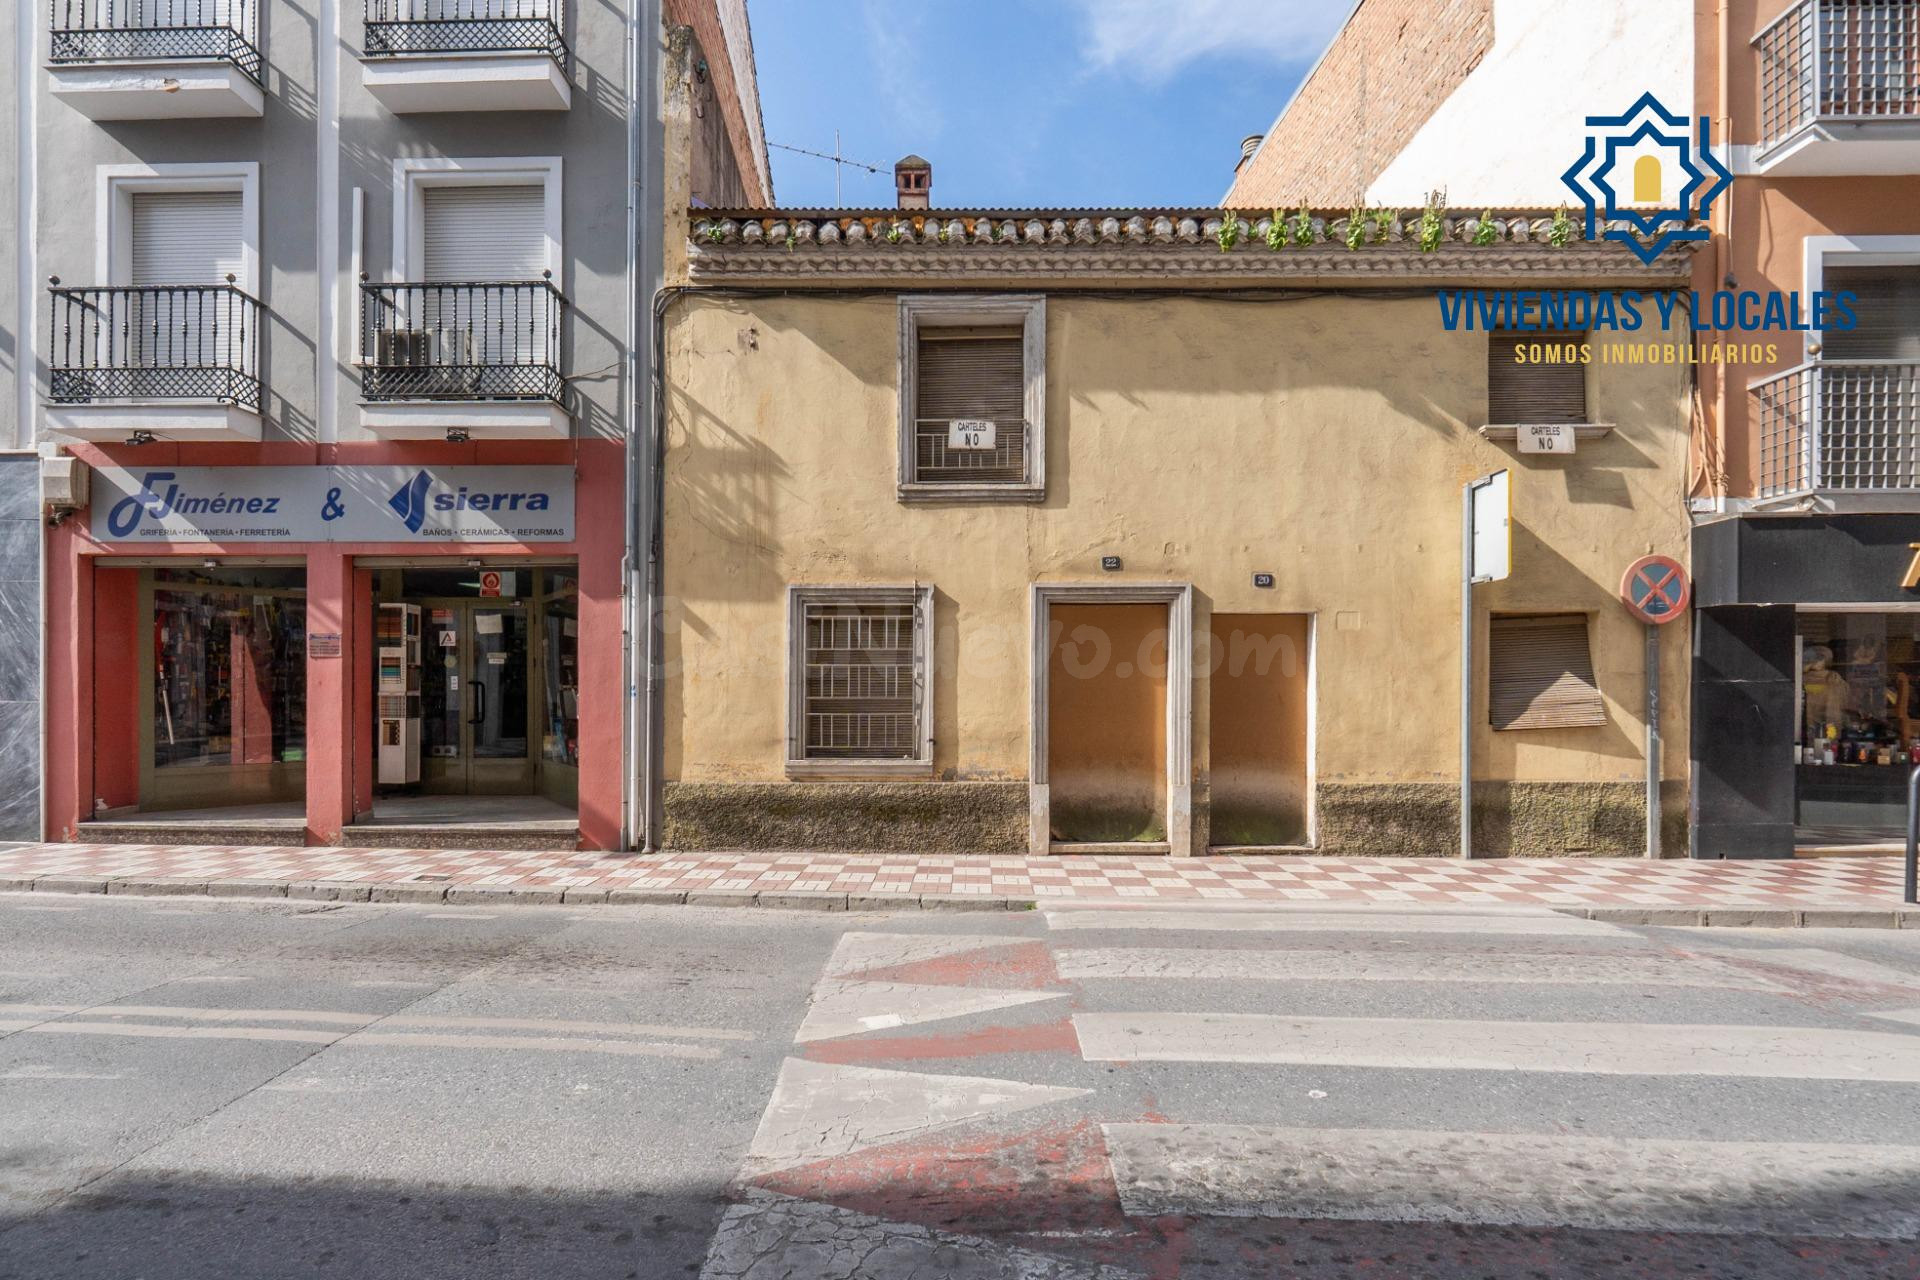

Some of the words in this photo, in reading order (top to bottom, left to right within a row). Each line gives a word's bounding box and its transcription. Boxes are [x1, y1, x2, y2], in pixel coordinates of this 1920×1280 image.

[957, 422, 987, 432] CARTELES
[1531, 426, 1561, 436] CARTELES
[320, 487, 345, 521] &
[433, 487, 549, 511] sierra
[239, 528, 291, 537] FERRETERÍA
[422, 528, 452, 537] BAÑOS
[460, 527, 510, 537] CERÁMICAS
[517, 528, 565, 537] REFORMAS
[1105, 558, 1117, 567] 22
[1257, 575, 1270, 585] 20
